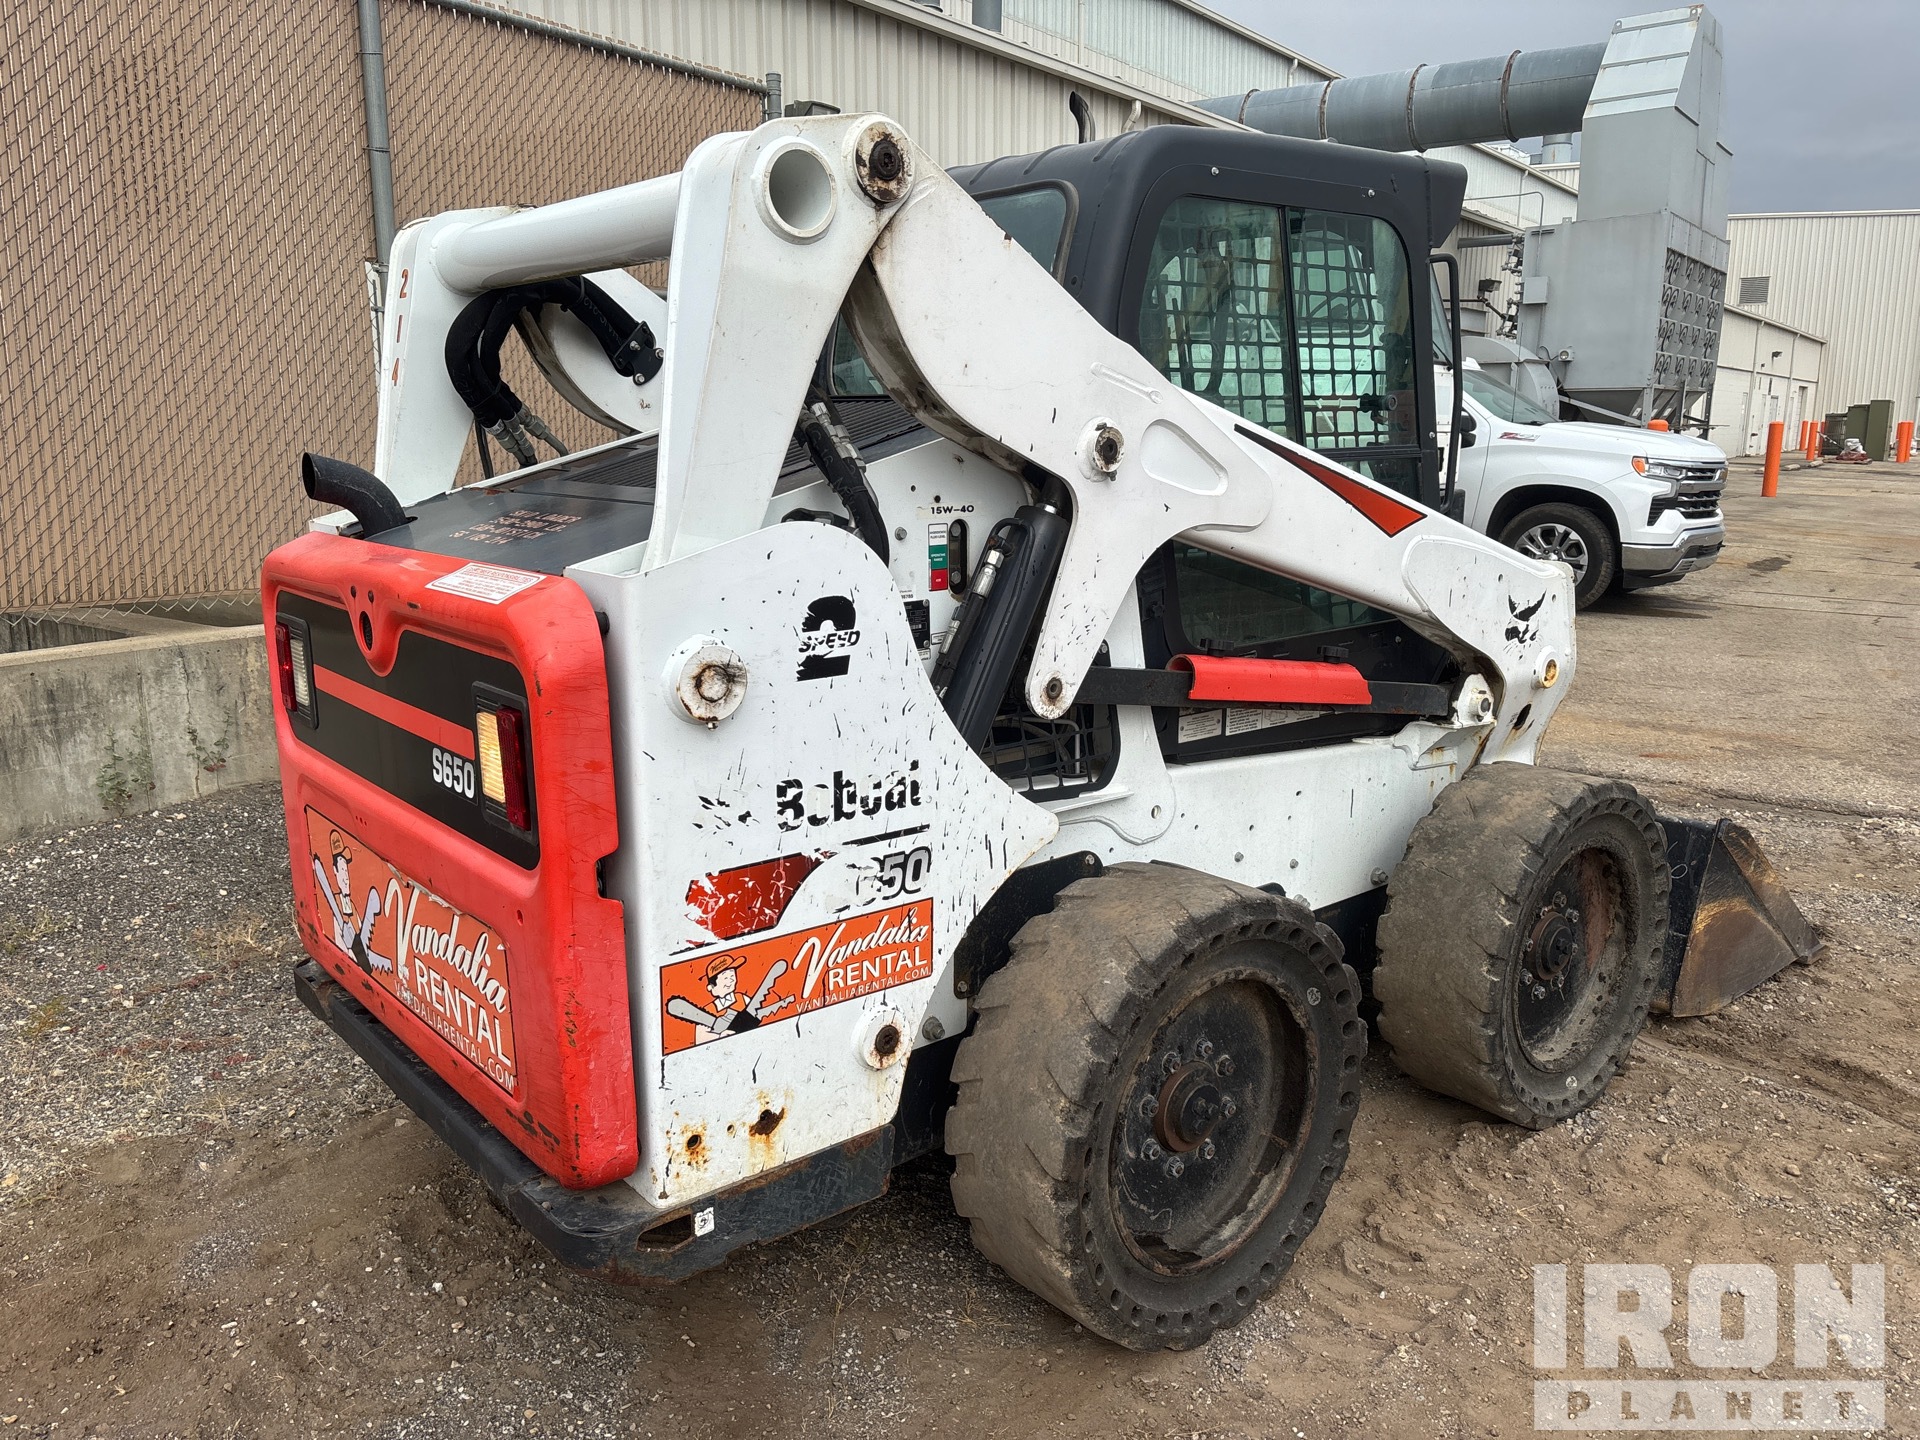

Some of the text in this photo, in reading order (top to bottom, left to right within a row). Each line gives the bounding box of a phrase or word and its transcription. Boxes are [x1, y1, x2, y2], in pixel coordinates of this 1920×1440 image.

[930, 504, 975, 515] 15W-40
[433, 748, 474, 796] S650
[776, 759, 922, 833] Bobcat
[384, 877, 507, 1014] Vandalia
[791, 906, 929, 1000] Vandalia
[827, 945, 929, 991] RENTAL
[413, 954, 512, 1067] RENTAL
[795, 966, 932, 1013] VANDALIARENTAL.COM
[393, 979, 517, 1091] VDALIARENTAL.COM
